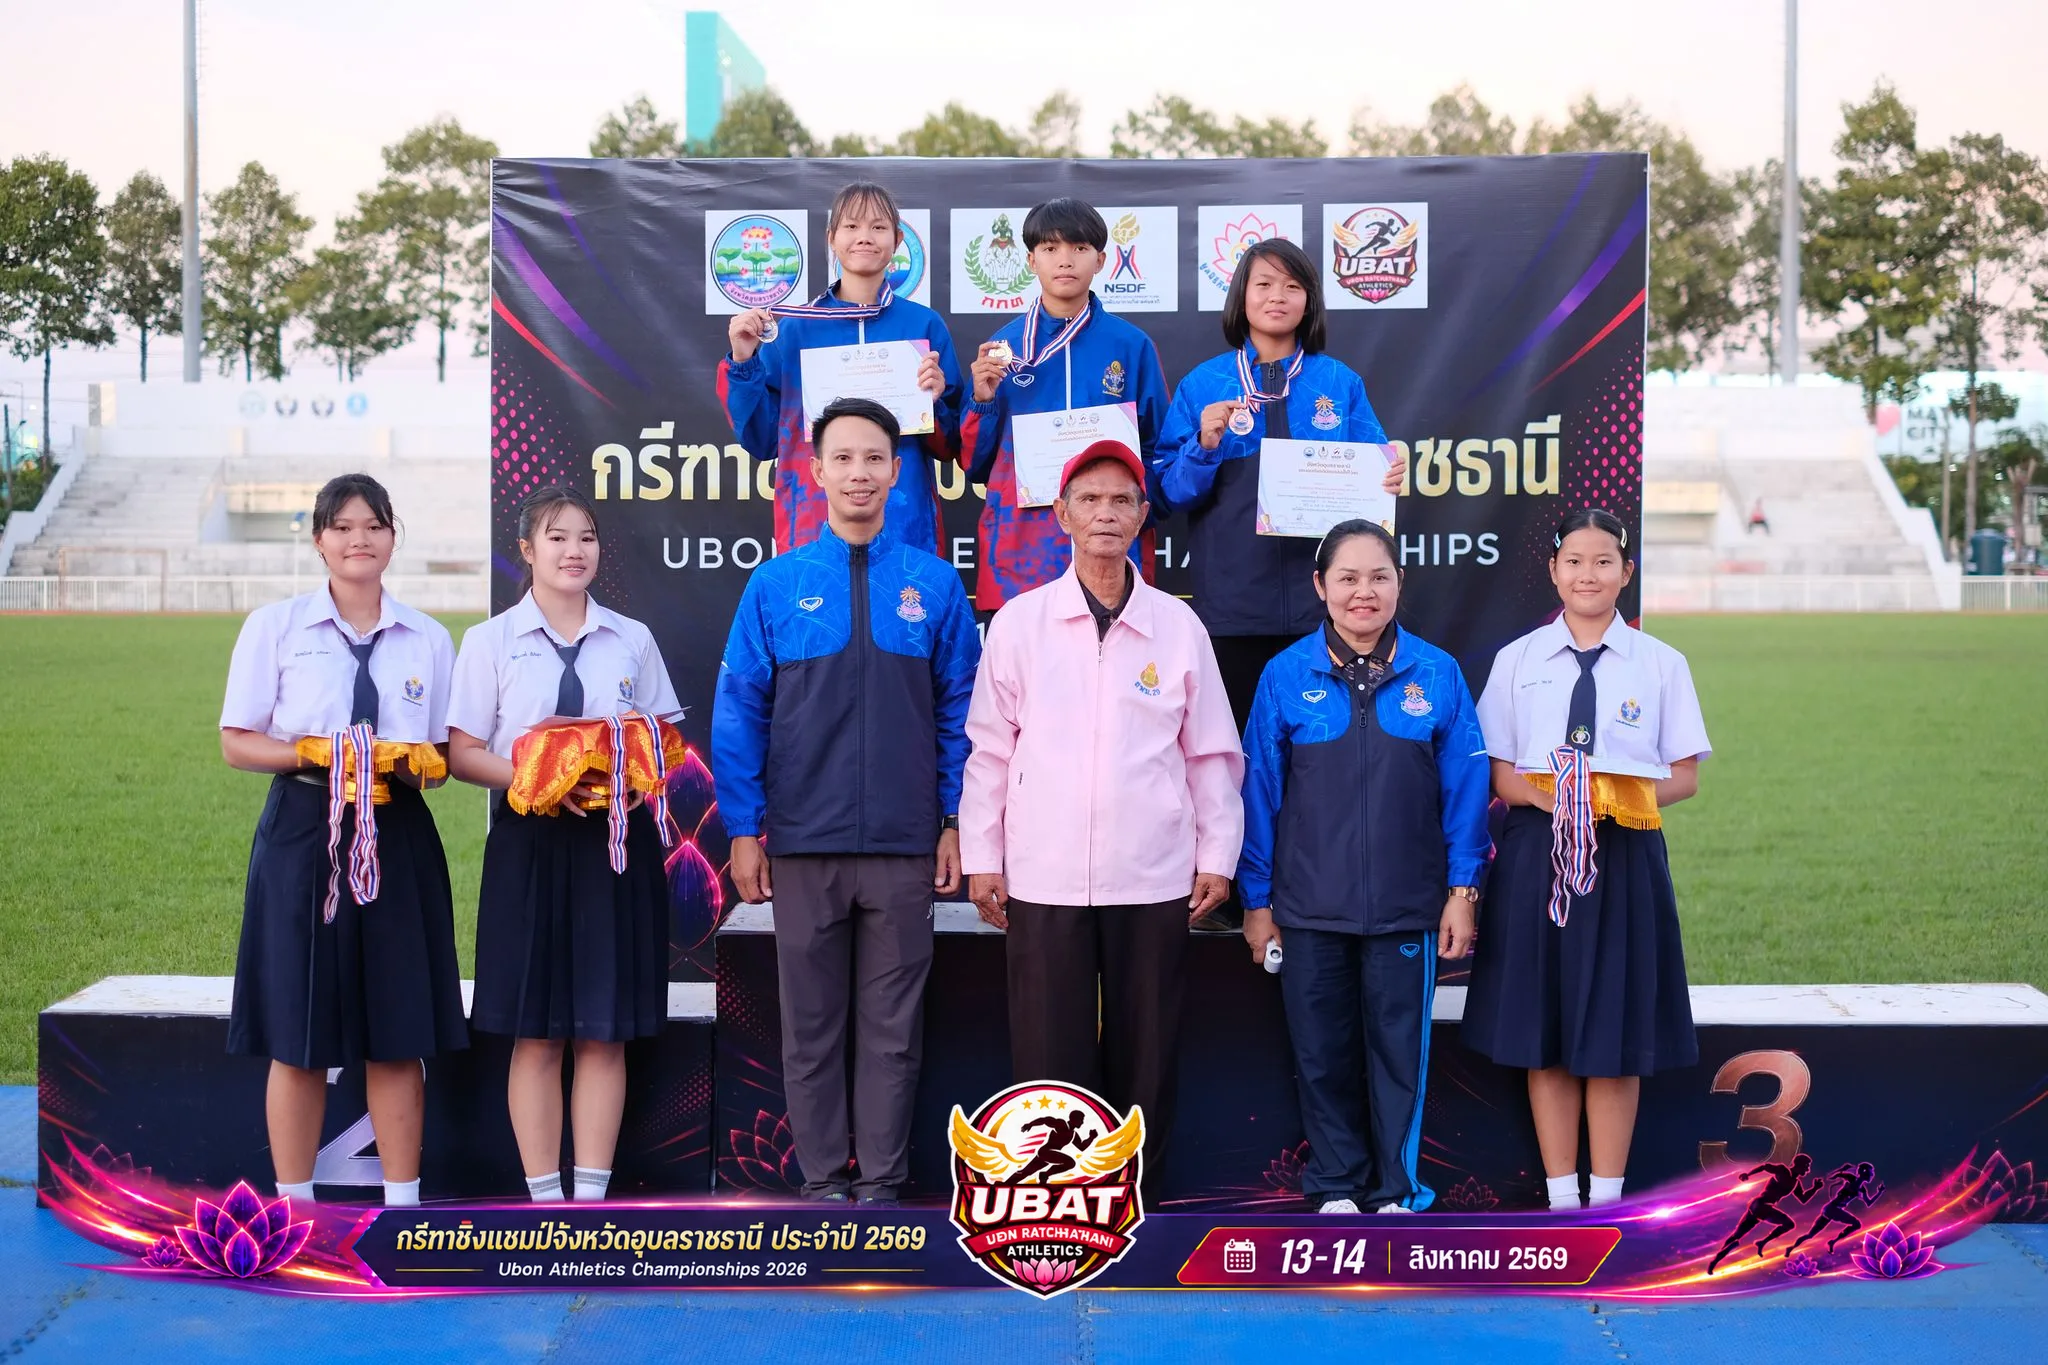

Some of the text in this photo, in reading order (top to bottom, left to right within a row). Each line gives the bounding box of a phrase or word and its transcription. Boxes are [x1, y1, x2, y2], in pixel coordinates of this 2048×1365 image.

[1340, 257, 1412, 276] UBAT
[1104, 283, 1147, 294] NSDF
[981, 296, 1024, 309] กกท
[663, 533, 1500, 569] UBO HIPS
[1699, 1049, 1811, 1176] 3
